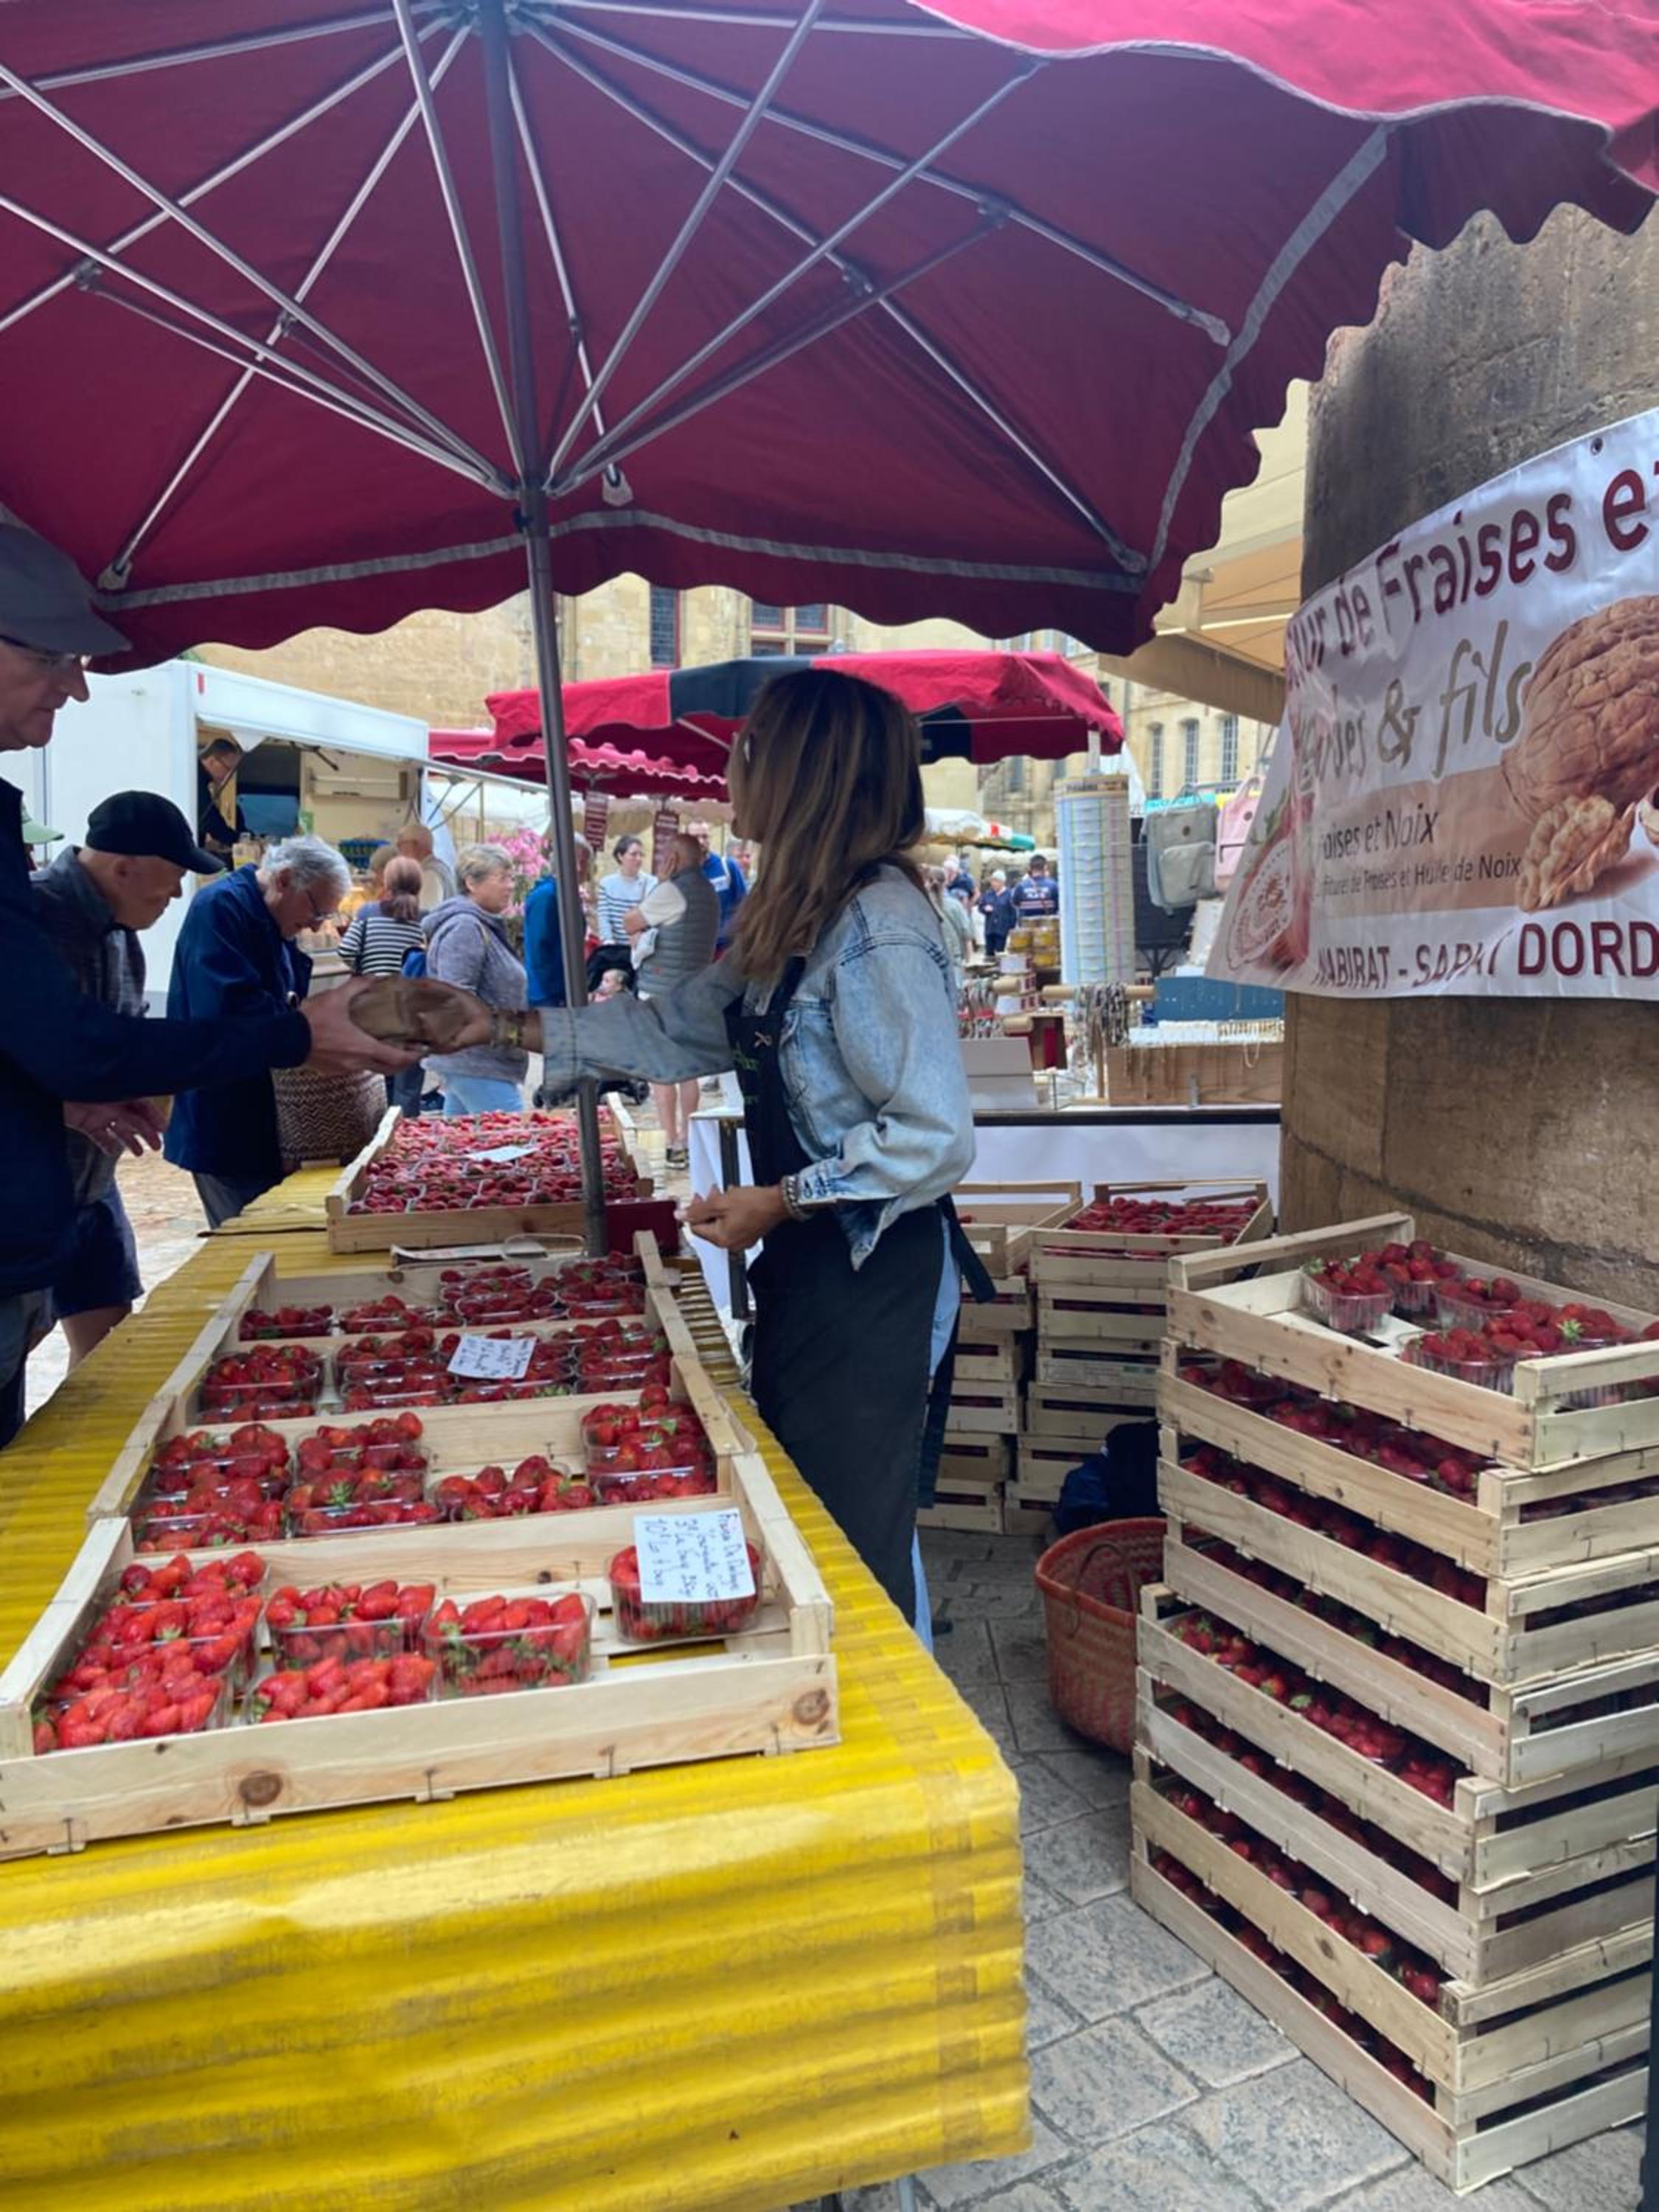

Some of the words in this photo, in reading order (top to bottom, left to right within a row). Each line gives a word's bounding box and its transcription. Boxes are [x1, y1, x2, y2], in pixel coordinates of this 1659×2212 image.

[1376, 493, 1576, 636] Fraises
[1603, 461, 1659, 552] e
[1377, 678, 1422, 771] &
[1432, 619, 1532, 779] fils
[1365, 815, 1382, 852] et
[1386, 802, 1438, 850] Noix
[1453, 855, 1473, 883] de
[1478, 852, 1523, 880] Noix
[1518, 921, 1659, 978] DORD
